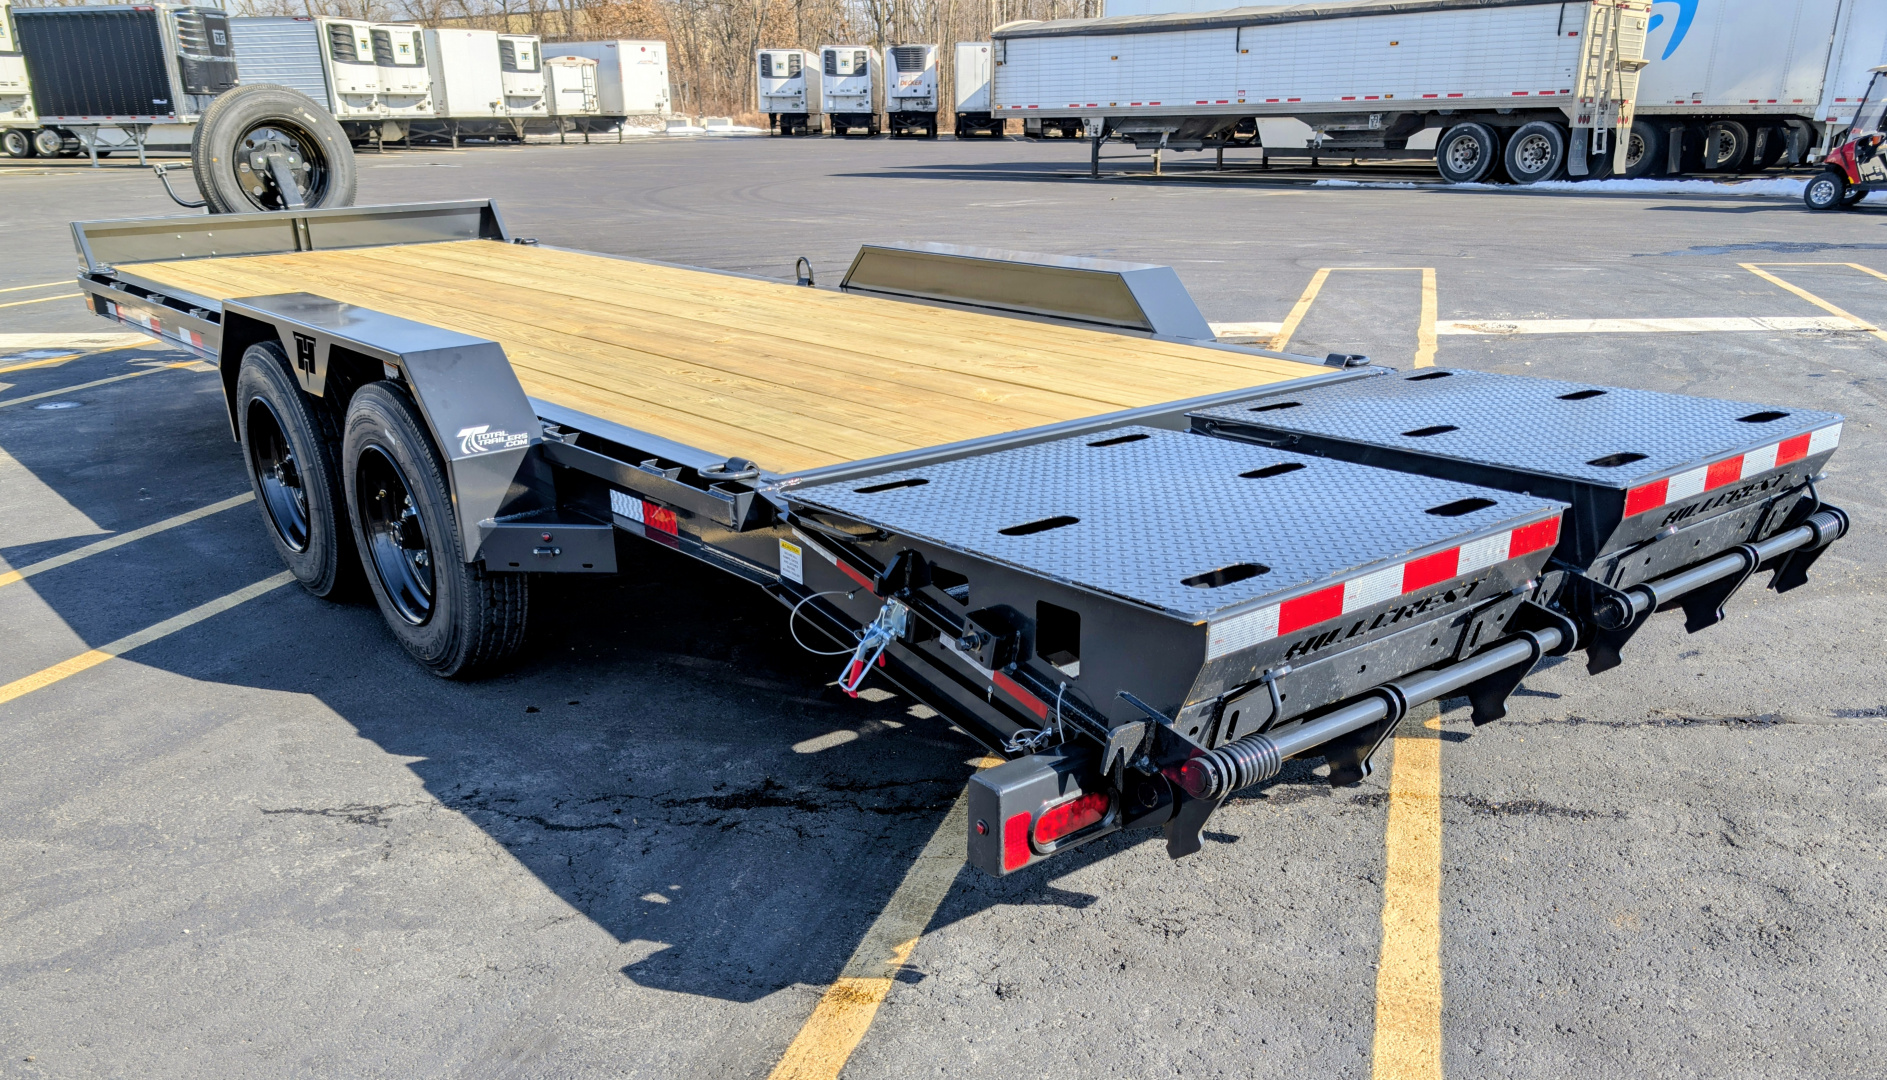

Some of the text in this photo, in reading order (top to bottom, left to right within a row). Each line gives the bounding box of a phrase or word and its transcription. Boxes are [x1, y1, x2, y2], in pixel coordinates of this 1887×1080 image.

[477, 430, 509, 441] TOTAL
[478, 432, 528, 446] TRAILERS
[504, 439, 528, 448] .COM
[1660, 472, 1790, 528] HILLCREST
[1283, 577, 1488, 661] HILLCREST
